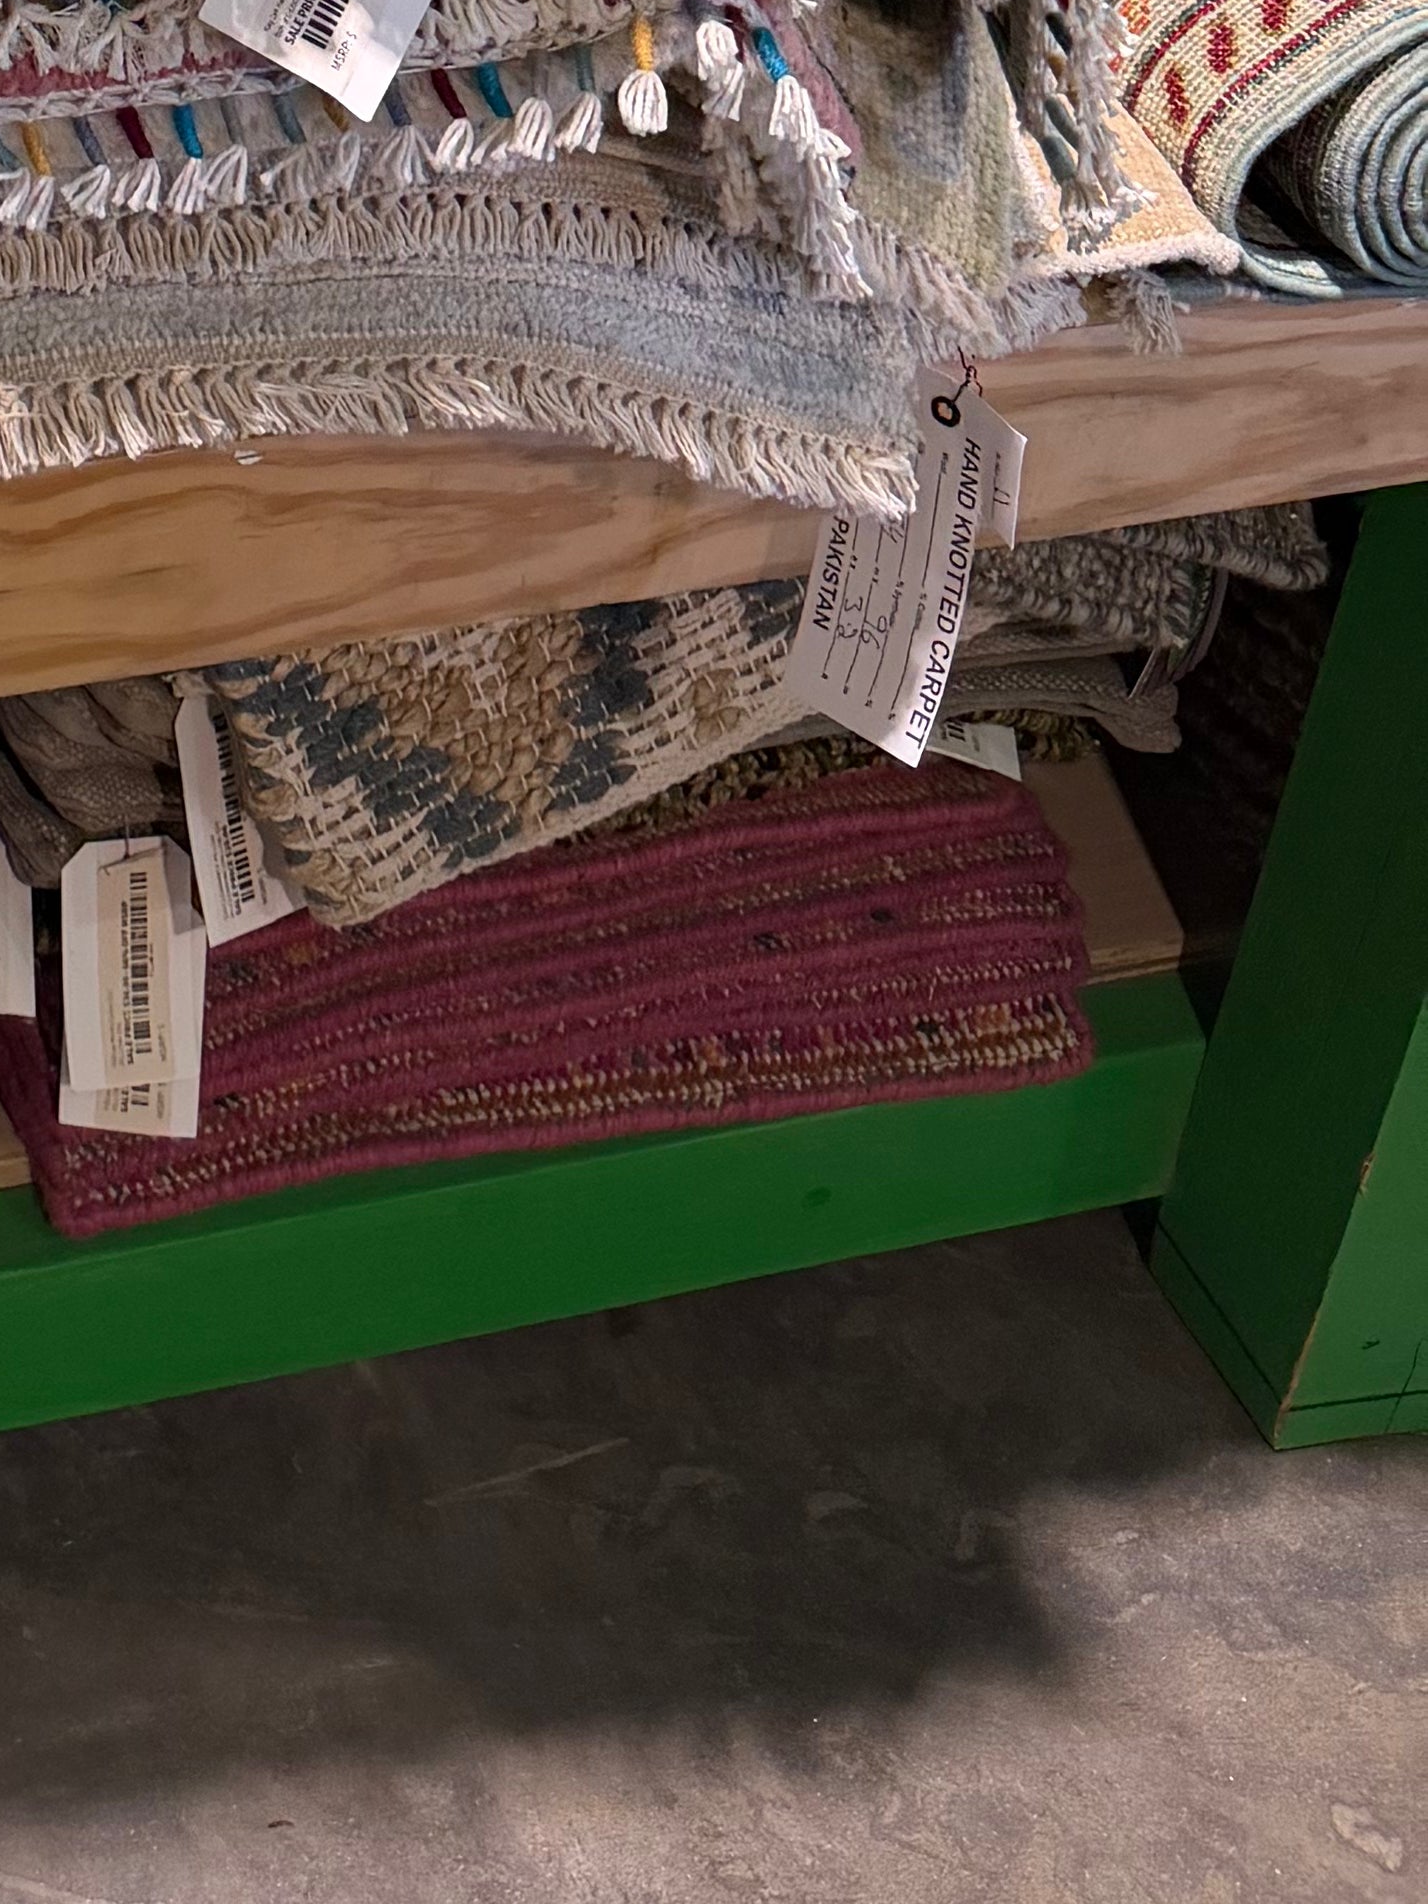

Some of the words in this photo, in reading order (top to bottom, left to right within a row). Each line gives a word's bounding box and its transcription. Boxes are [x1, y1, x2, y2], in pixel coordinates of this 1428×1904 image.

[285, 16, 305, 45] SALE
[957, 438, 981, 509] HAND
[813, 516, 850, 630] PAKISTAN
[938, 514, 975, 634] KNOTTED
[859, 615, 889, 649] 96
[906, 641, 949, 748] CARPET
